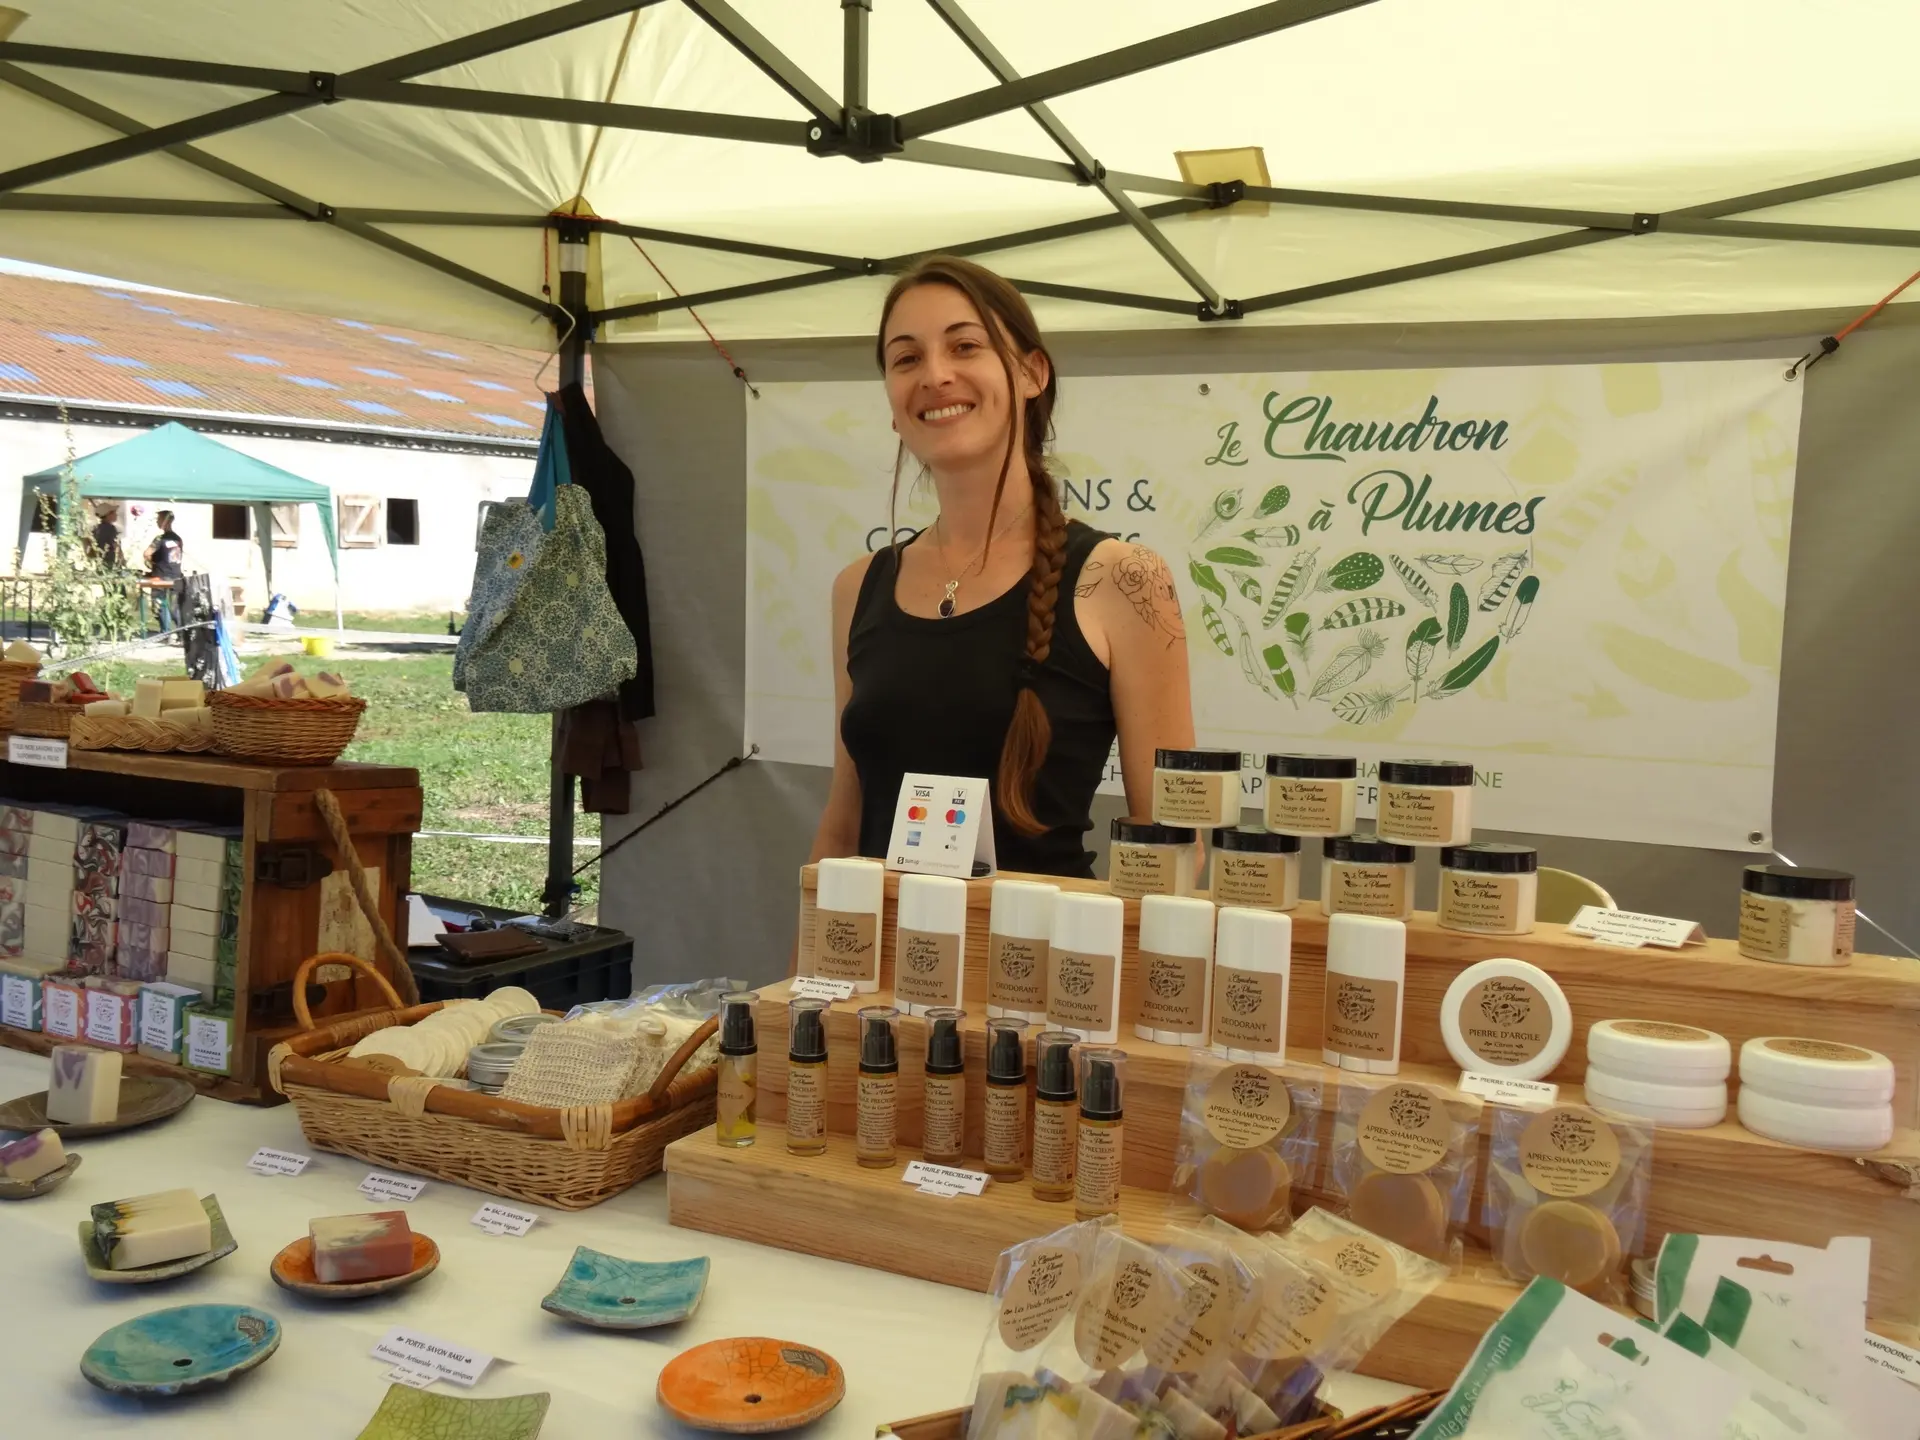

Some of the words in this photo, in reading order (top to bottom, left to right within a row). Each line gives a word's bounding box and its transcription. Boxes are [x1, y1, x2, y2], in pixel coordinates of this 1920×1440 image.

[1204, 421, 1248, 466] Le
[1262, 391, 1509, 463] Chaudron
[1126, 479, 1157, 512] &
[1307, 499, 1332, 533] à
[1347, 470, 1546, 537] Plumes
[915, 790, 931, 798] VISA
[806, 979, 843, 989] DEODORANT
[1468, 1028, 1498, 1039] PIERRE
[1500, 1029, 1541, 1042] D'ARGILE
[1479, 1076, 1505, 1086] PIERRE
[1506, 1080, 1540, 1091] D'ARGILE
[921, 1165, 941, 1175] HUILE
[941, 1168, 974, 1181] PRECIEUSE
[426, 1345, 448, 1357] SAVON
[448, 1352, 465, 1362] RAKU
